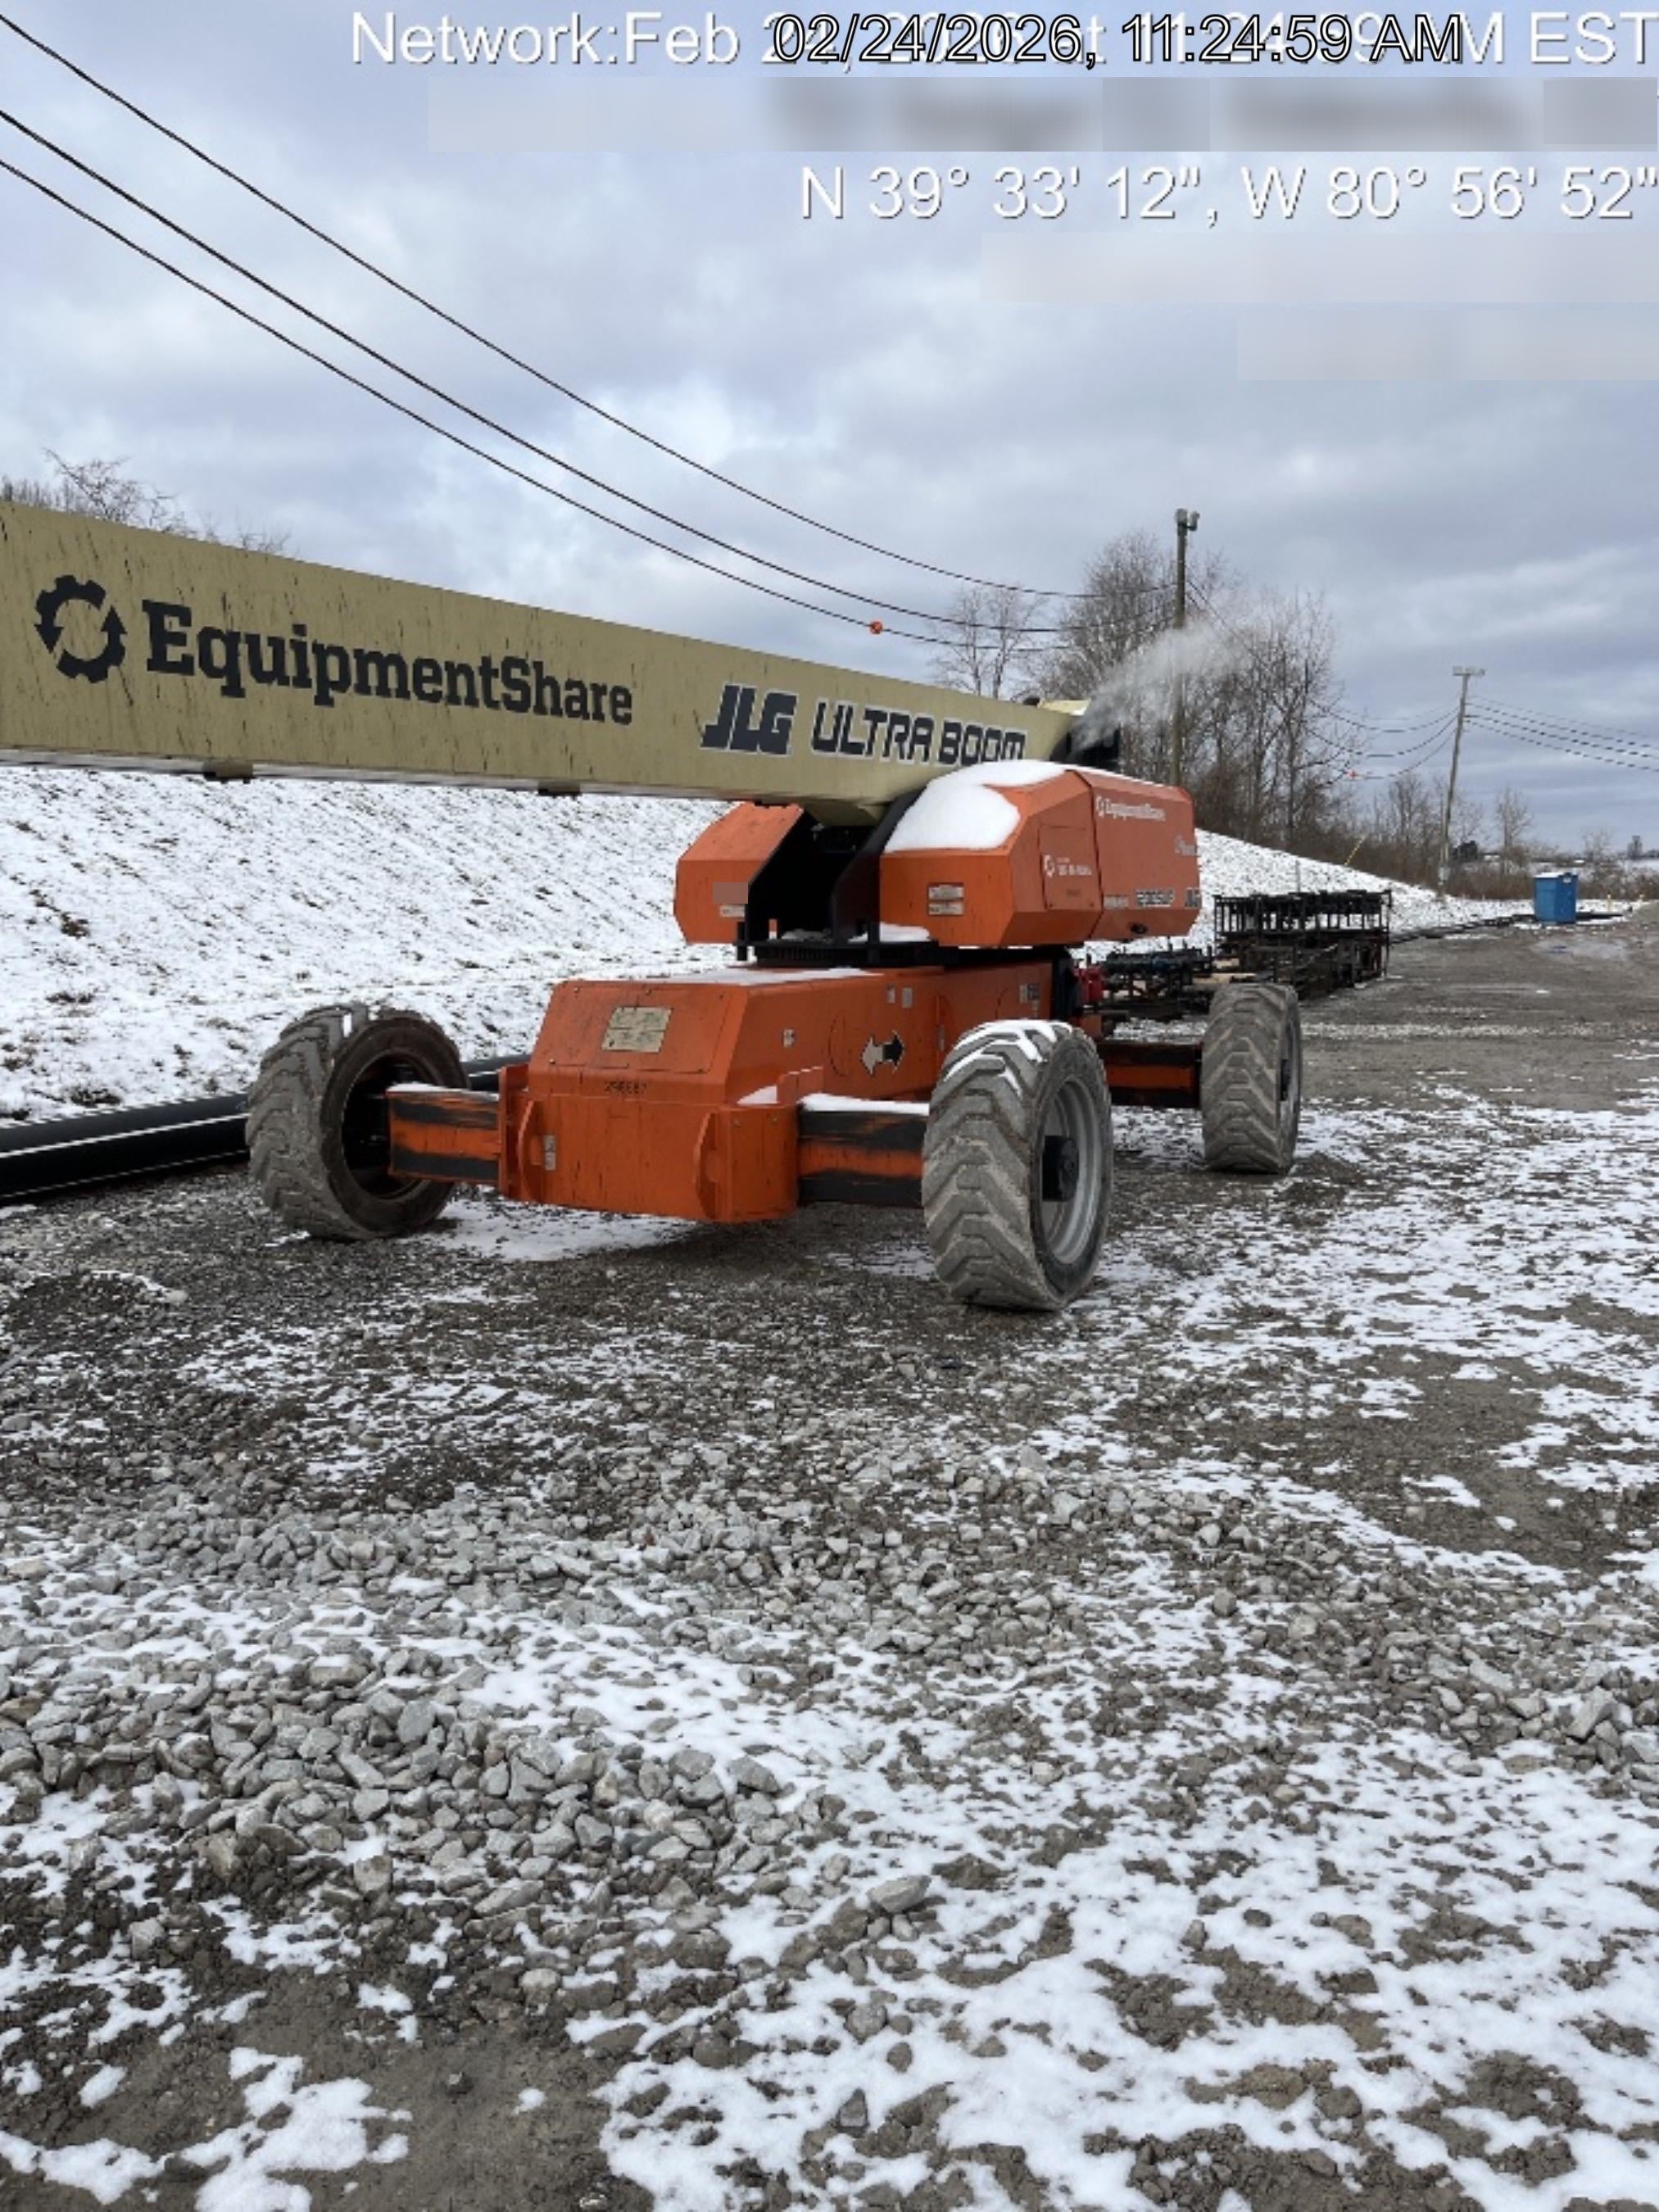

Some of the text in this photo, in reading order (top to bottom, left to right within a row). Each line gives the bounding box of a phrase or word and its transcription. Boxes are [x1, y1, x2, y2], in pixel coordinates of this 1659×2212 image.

[141, 598, 633, 727] EquipmentShare
[700, 683, 1027, 765] JLG ULTRA BOOM
